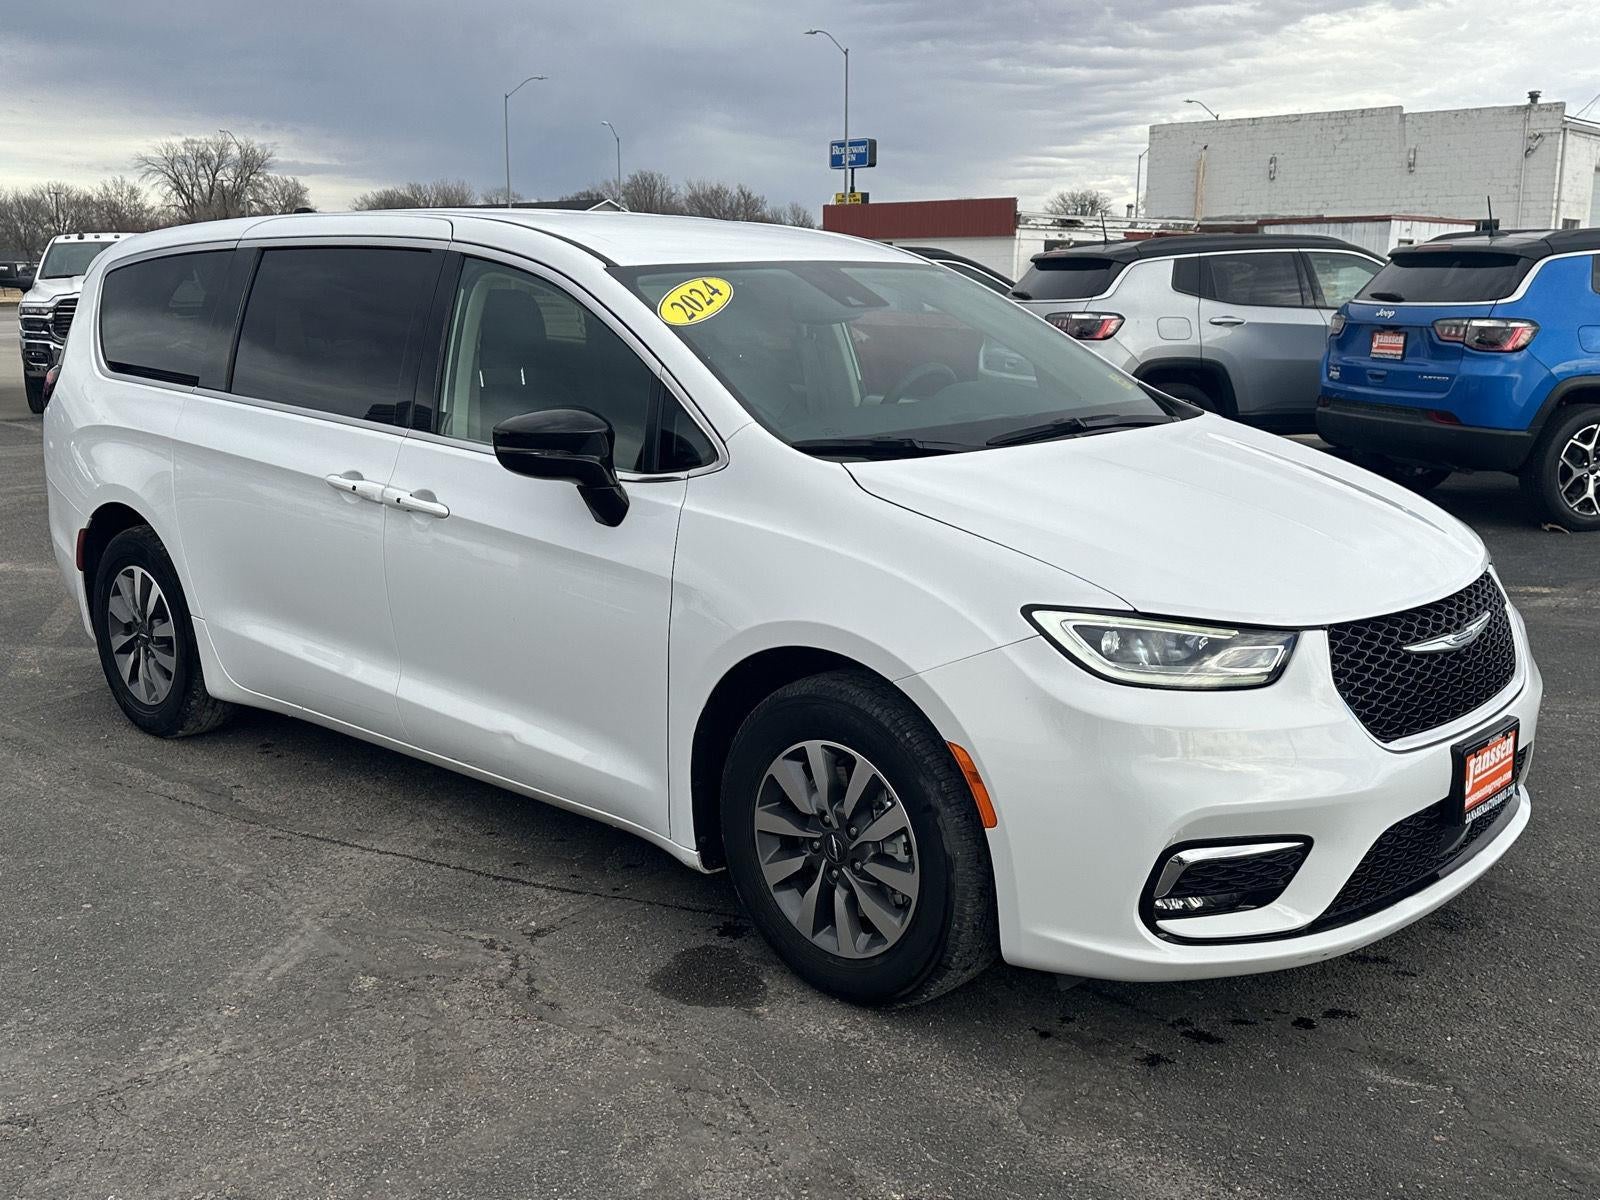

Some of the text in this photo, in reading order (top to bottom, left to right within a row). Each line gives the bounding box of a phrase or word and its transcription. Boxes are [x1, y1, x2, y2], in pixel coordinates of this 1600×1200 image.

[670, 280, 723, 321] 2024
[1376, 308, 1396, 319] Jeep
[1465, 734, 1514, 796] Janssen
